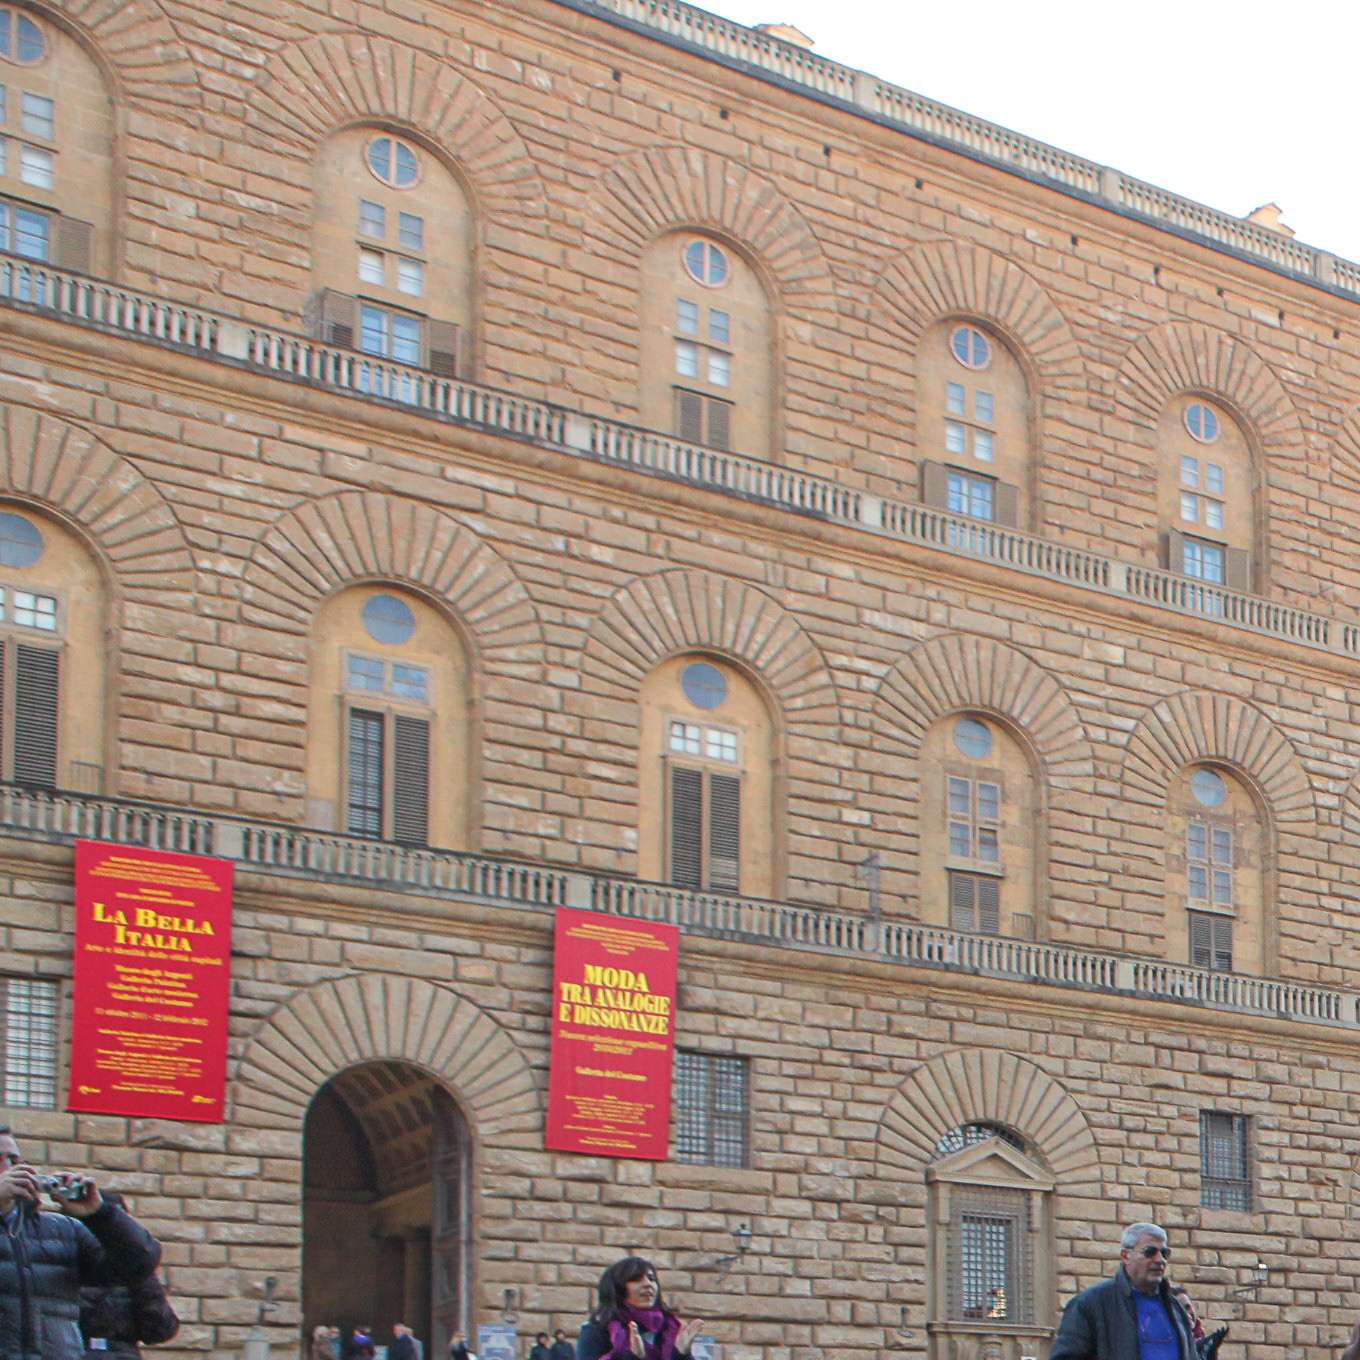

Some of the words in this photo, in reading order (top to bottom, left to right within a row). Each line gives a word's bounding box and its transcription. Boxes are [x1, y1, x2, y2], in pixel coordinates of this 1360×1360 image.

[93, 902, 128, 925] LA
[135, 908, 215, 935] BELLA
[114, 924, 192, 951] ITALIA
[584, 963, 650, 993] MODA
[559, 981, 593, 1005] TRA
[594, 987, 671, 1015] ANALOGIE
[559, 1002, 572, 1023] E
[573, 1004, 669, 1035] DISSONANZE
